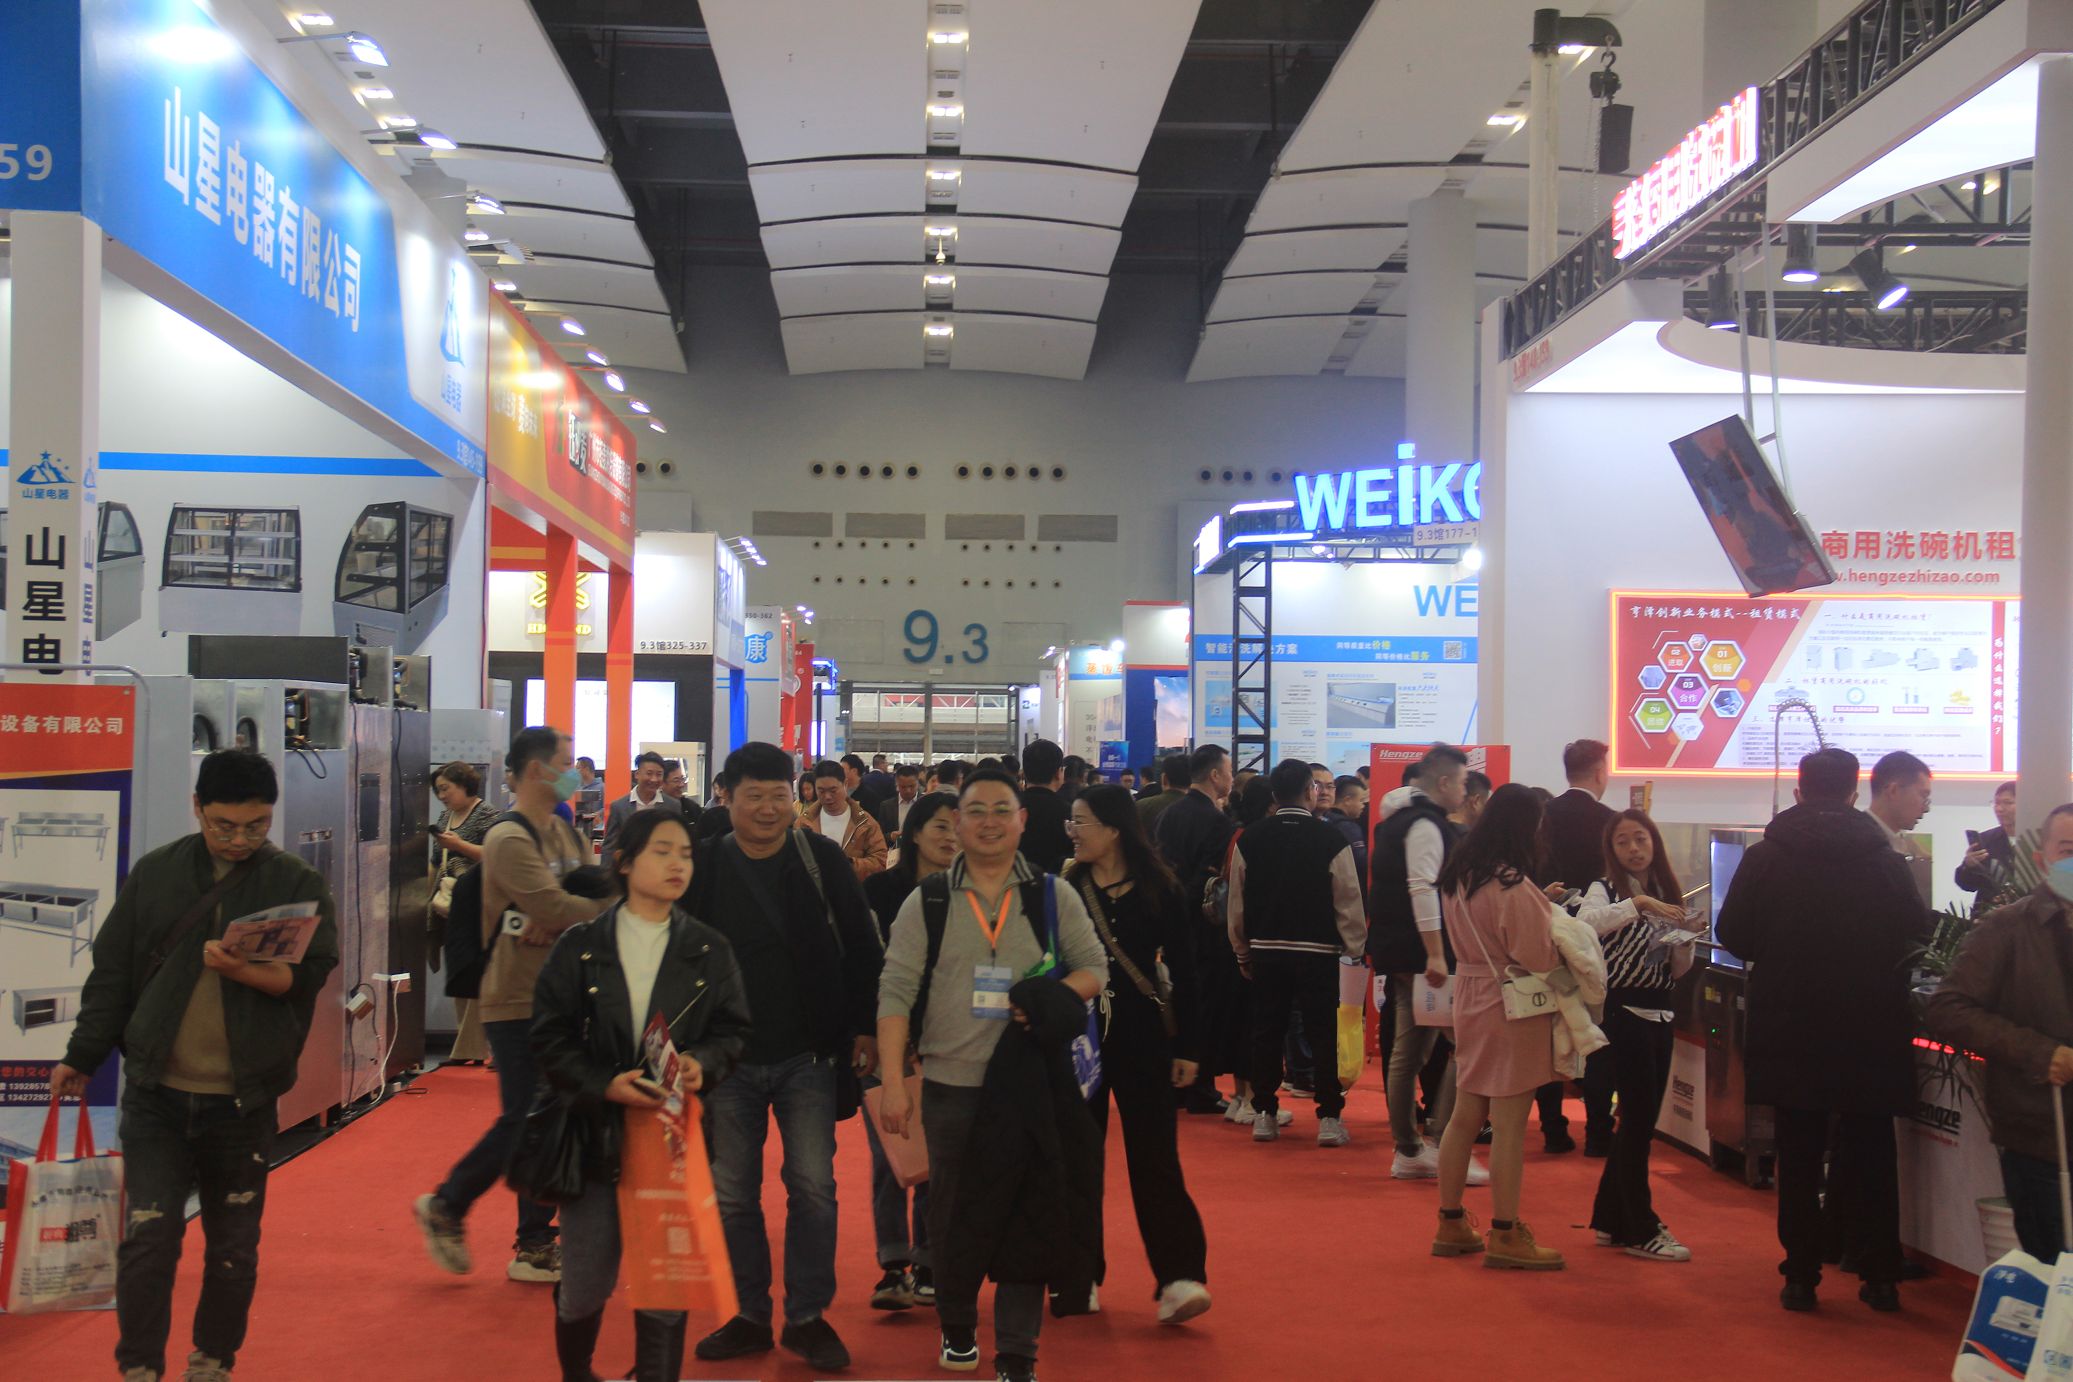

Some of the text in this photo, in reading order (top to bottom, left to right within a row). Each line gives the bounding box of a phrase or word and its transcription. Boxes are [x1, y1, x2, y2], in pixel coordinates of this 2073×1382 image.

[0, 143, 53, 181] 59
[163, 86, 361, 332] 山星电器有限公司
[22, 488, 70, 500] 山星电器
[1820, 530, 2021, 561] 商用洗碗机租
[22, 526, 67, 675] 山星电
[640, 640, 708, 652] 9.3馆325-337
[746, 635, 767, 661] 康
[903, 609, 990, 665] 9.3
[1717, 650, 1728, 658] 01
[1682, 681, 1694, 689] 03
[1679, 694, 1697, 703] 合作
[0, 714, 125, 735] 设备有限公司
[1379, 749, 1424, 760] Hengze
[1917, 1101, 1961, 1130] engze
